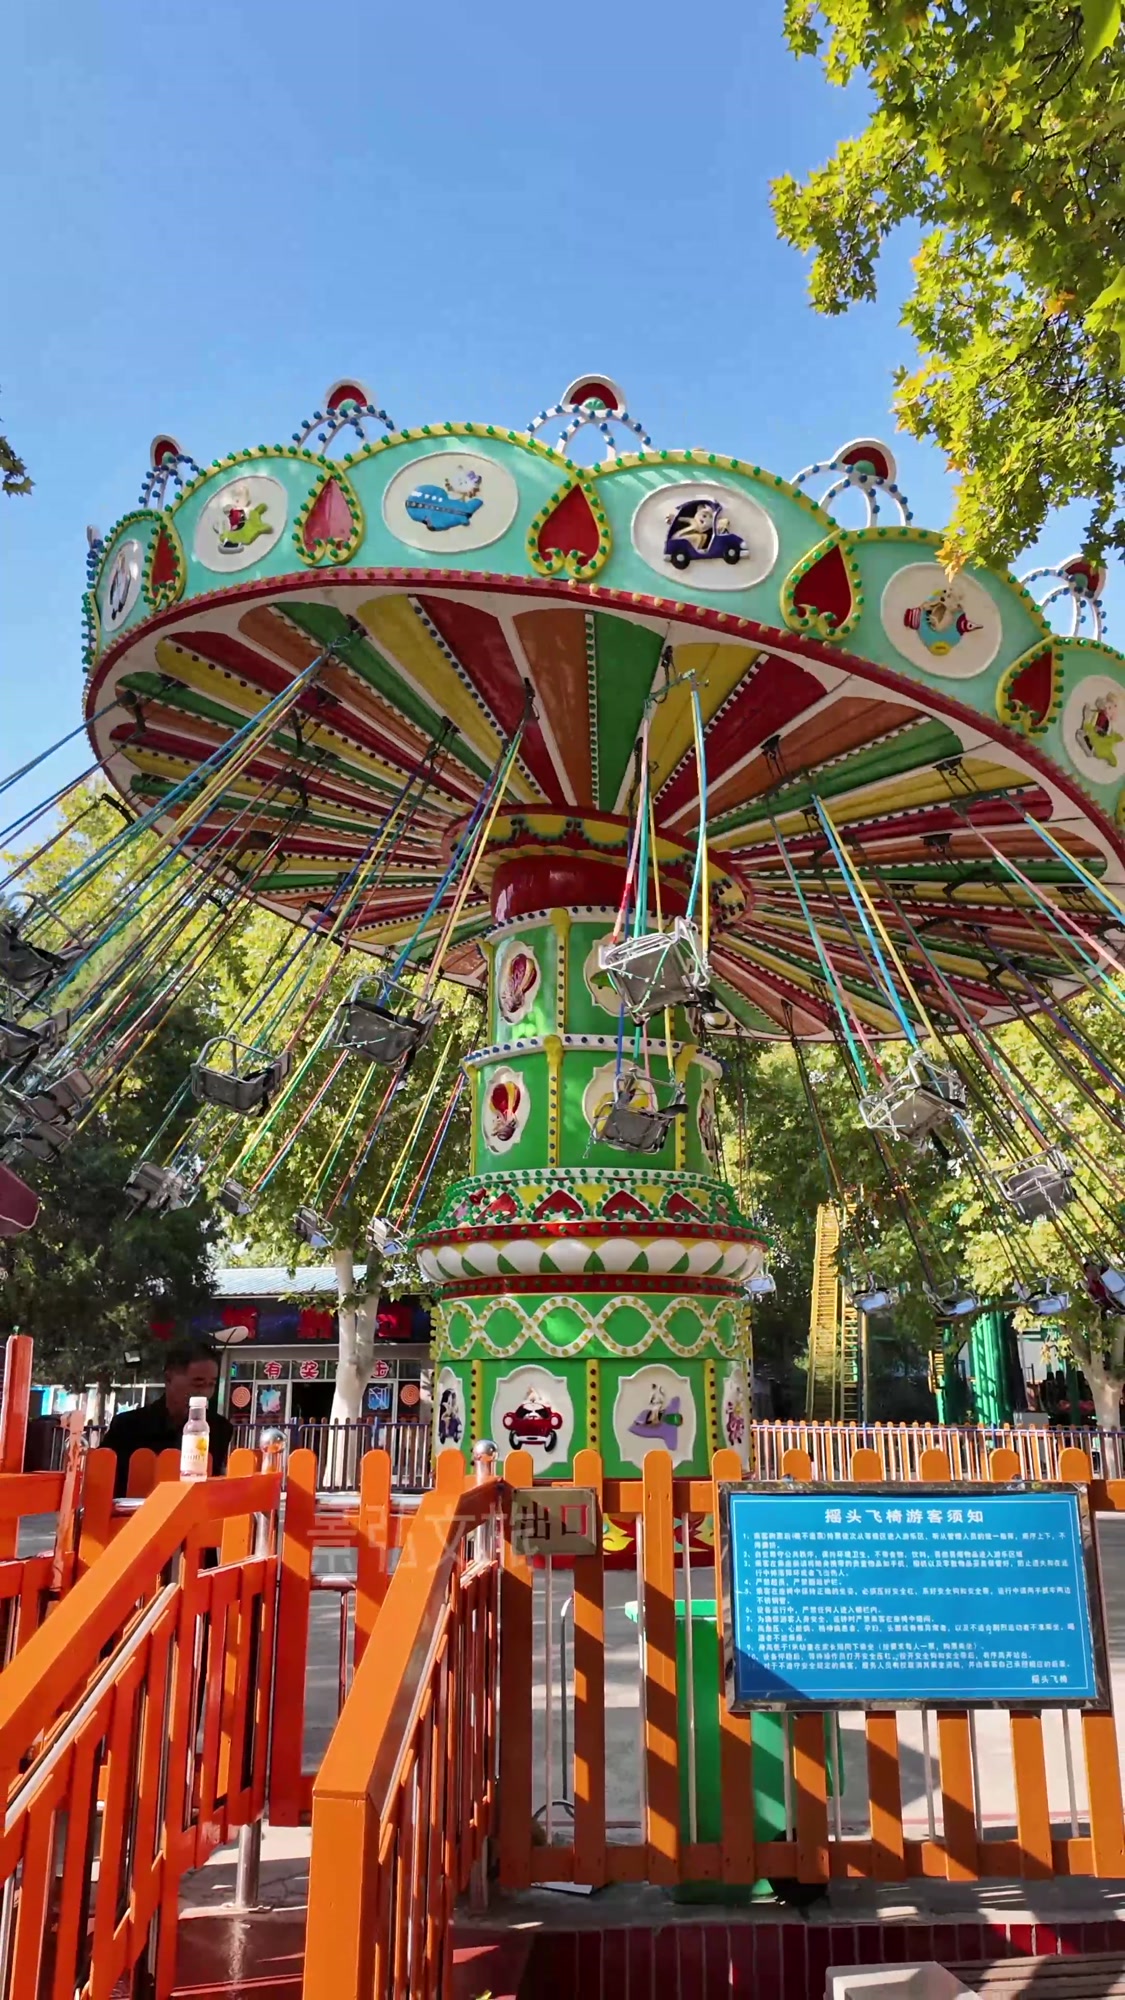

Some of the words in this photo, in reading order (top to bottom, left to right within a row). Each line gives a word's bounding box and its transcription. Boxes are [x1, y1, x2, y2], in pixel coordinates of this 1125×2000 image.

[520, 1501, 589, 1540] 出口
[825, 1508, 984, 1523] 摇头飞椅游客须知
[1031, 1674, 1068, 1684] 摇头飞椅
